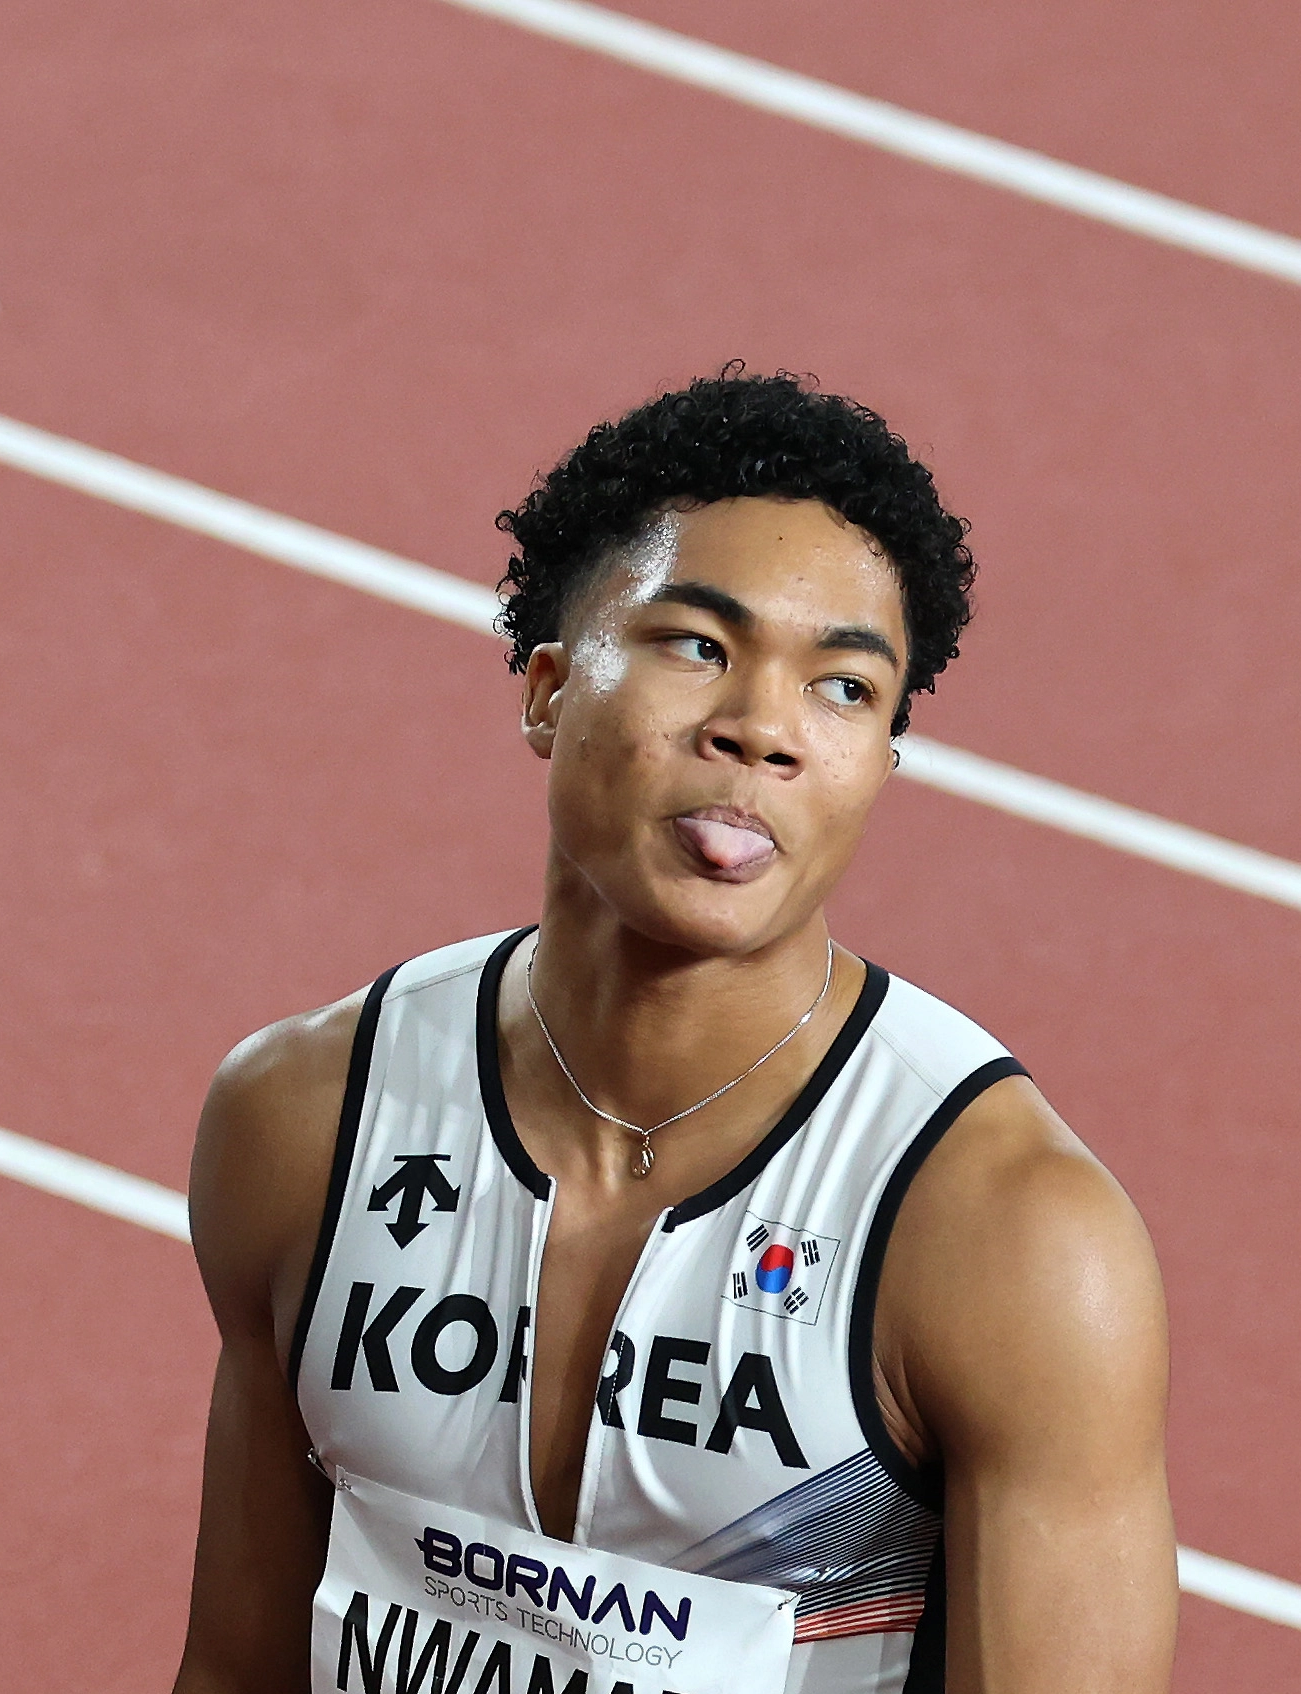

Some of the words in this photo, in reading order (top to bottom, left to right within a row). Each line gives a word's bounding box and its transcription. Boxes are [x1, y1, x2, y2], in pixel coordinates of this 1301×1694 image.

[330, 1281, 811, 1470] KOREA
[413, 1526, 692, 1642] BORNAN
[424, 1575, 508, 1622] SPORTS
[516, 1607, 684, 1670] TECHNOLOGY
